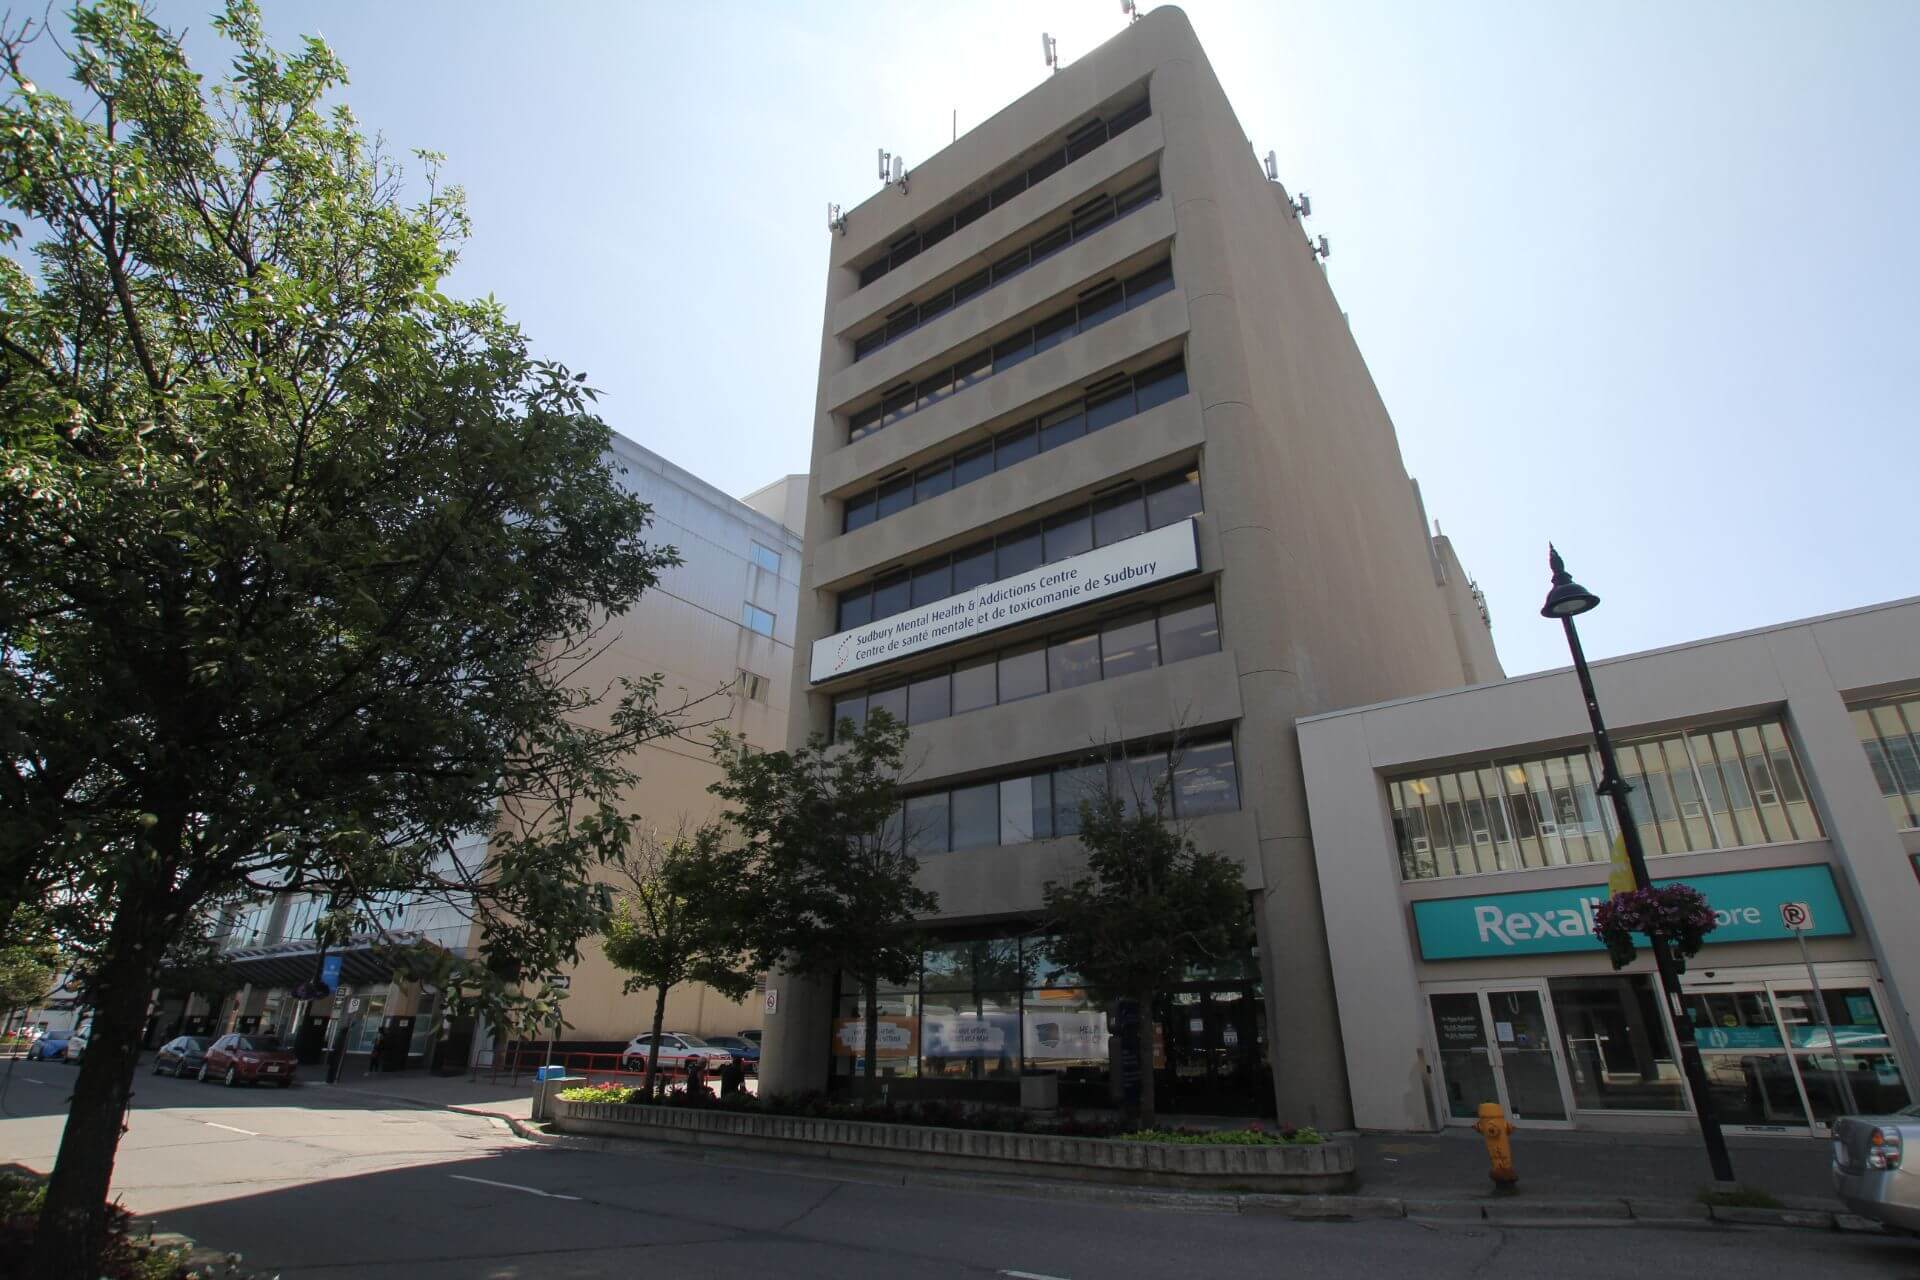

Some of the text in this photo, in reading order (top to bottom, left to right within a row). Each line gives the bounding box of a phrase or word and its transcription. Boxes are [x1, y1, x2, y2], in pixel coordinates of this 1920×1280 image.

[855, 561, 1157, 660] Centre de santé mentale et de toxicomanie de Sudbury
[856, 569, 1078, 646] Sudbury Mental Health & Addictions Centre
